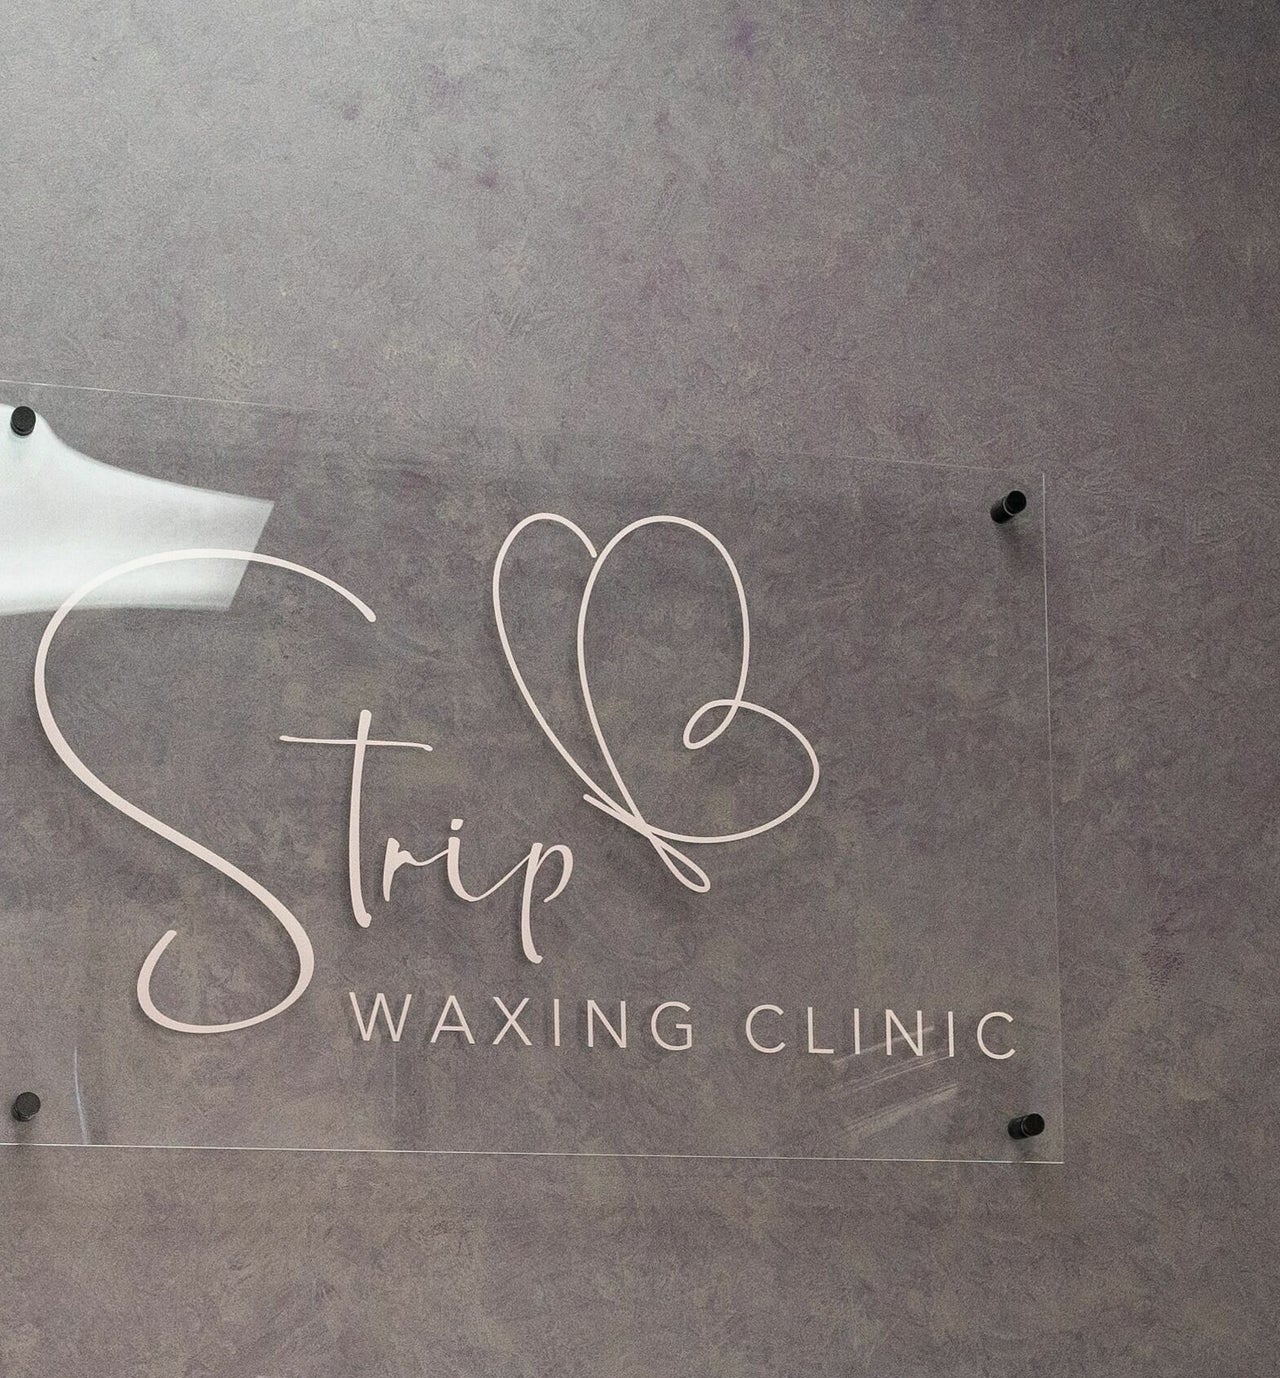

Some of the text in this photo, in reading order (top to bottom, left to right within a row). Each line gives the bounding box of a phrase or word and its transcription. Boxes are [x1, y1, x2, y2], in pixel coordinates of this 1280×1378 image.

[32, 546, 575, 1036] Strip
[348, 992, 1018, 1061] WAXING CLINIC
